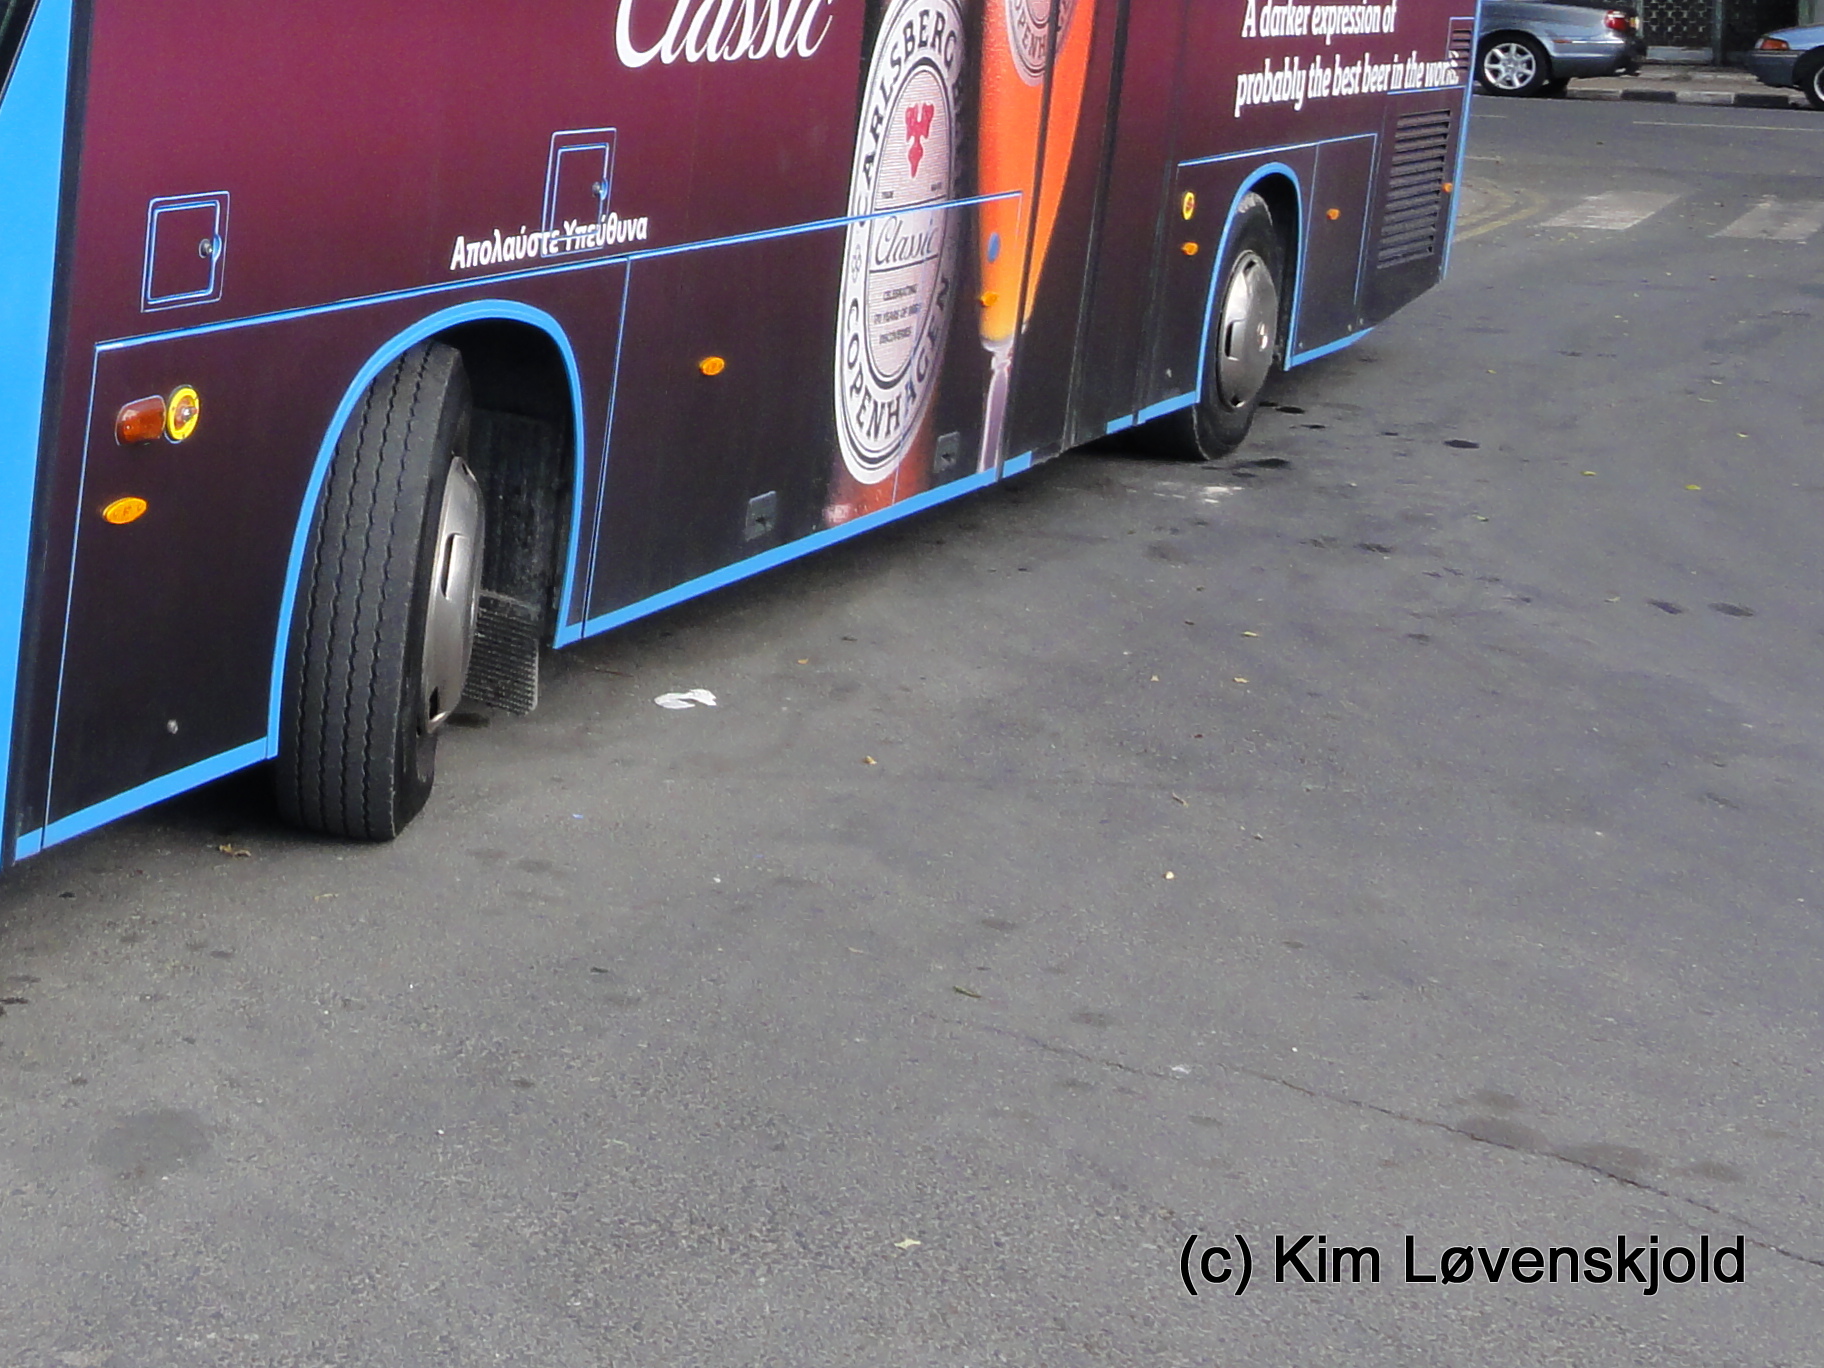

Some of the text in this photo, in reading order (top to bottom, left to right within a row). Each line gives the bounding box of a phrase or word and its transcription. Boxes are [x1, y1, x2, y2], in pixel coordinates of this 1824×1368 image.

[1234, 57, 1307, 118] probably
[1307, 55, 1332, 99] the
[1332, 54, 1363, 97] best
[1361, 52, 1391, 94] beer
[1390, 53, 1405, 90] in
[1404, 50, 1425, 89] the
[449, 211, 649, 271] Απολαύστε Υπεύθυνα
[875, 215, 940, 266] Classic
